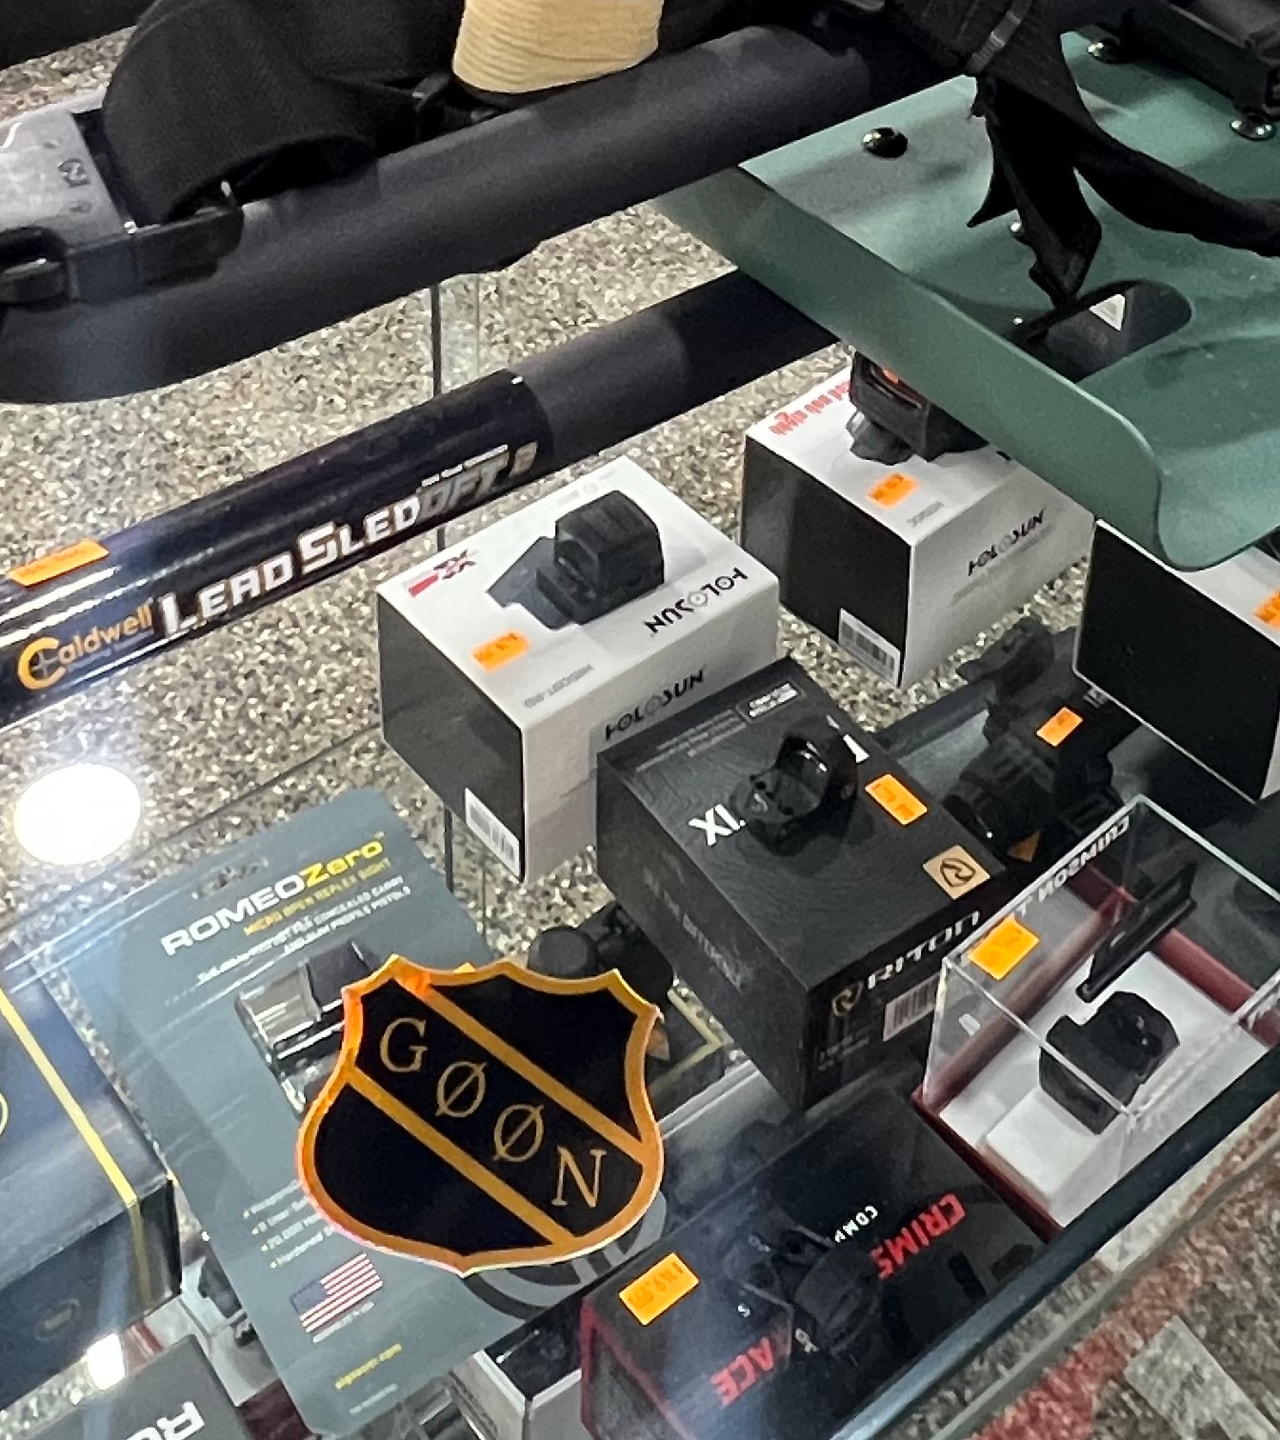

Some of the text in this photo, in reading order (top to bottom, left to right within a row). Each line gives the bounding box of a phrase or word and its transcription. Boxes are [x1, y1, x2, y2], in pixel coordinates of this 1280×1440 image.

[967, 508, 1046, 576] HOLOSUN
[17, 599, 154, 690] Caldwell
[157, 551, 293, 640] LEAD
[297, 520, 421, 574] SLED
[643, 567, 748, 634] HOLOSUN
[605, 669, 705, 741] HOLOSUN
[867, 911, 981, 991] RITON
[871, 1192, 967, 1281] CRIMS
[711, 1336, 775, 1408] ACE
